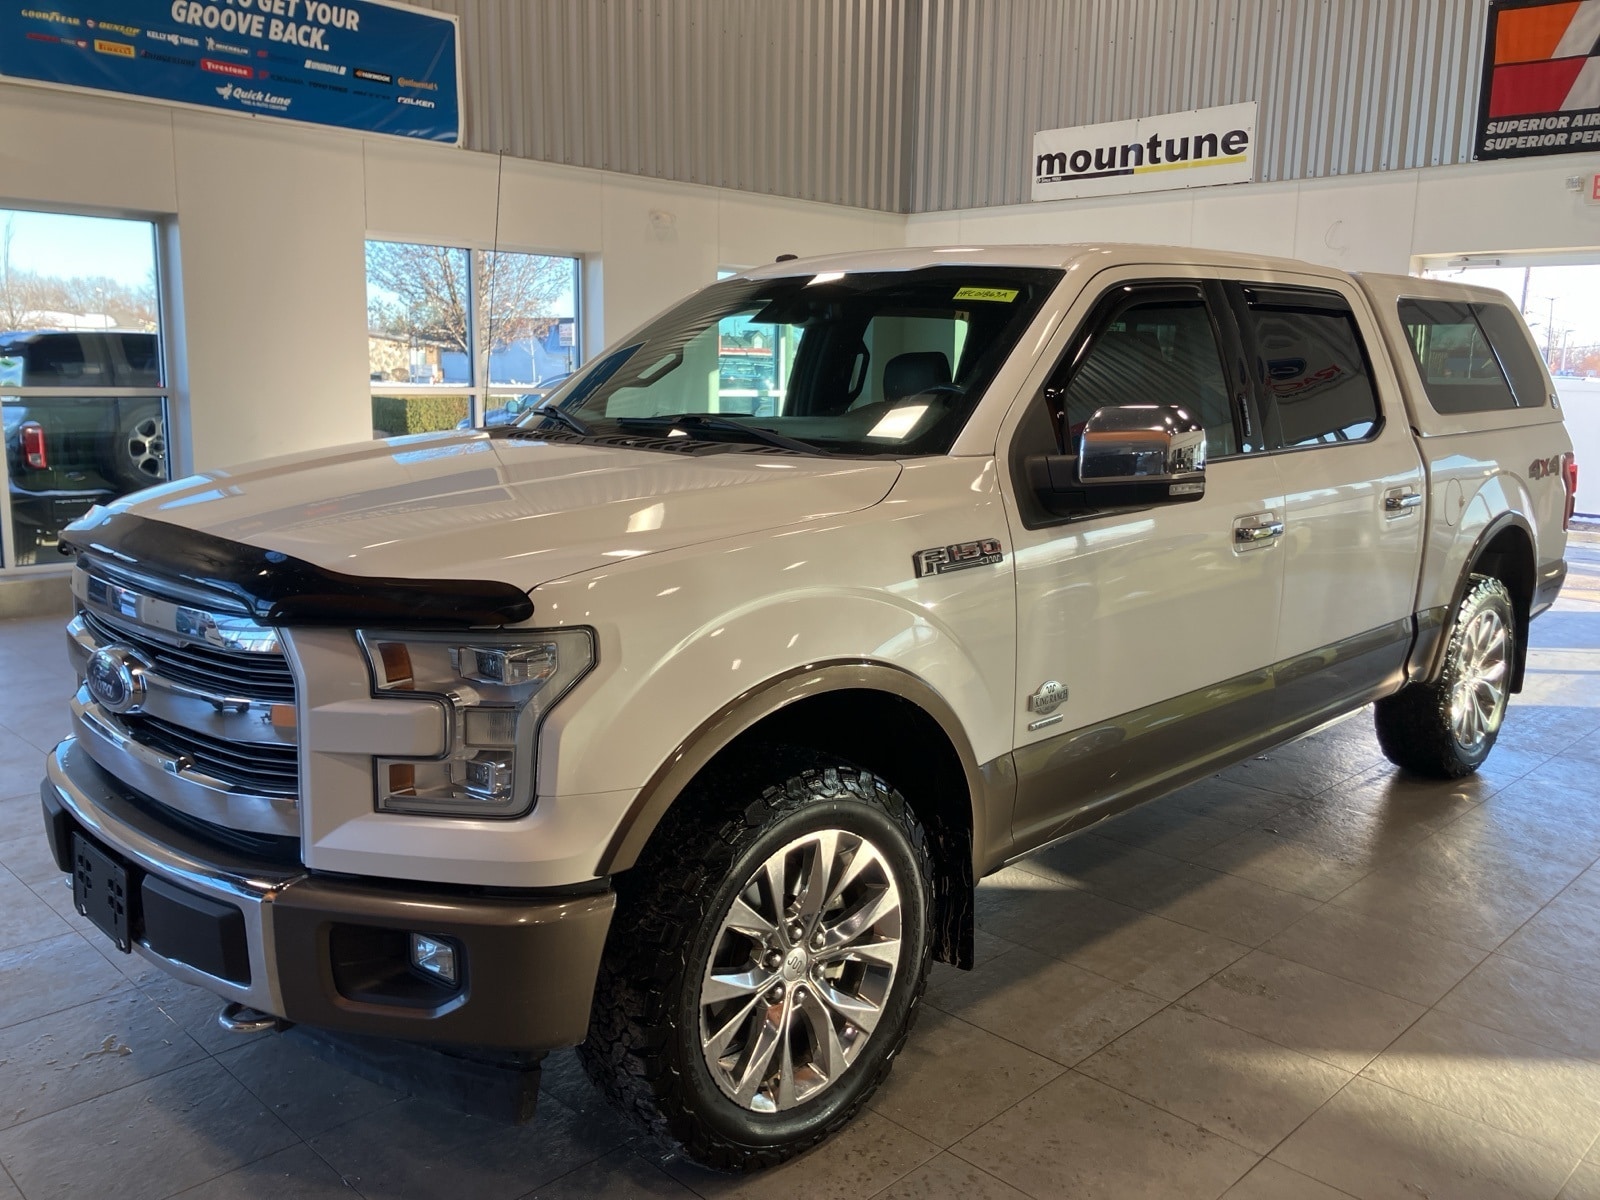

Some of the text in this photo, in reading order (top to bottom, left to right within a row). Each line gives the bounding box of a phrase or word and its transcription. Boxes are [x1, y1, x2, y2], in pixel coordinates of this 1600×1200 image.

[21, 9, 80, 26] GOODYEAR
[171, 0, 330, 51] GROOVE BACK.
[304, 0, 360, 31] YOUR
[233, 86, 292, 106] Quick Lane
[1486, 116, 1570, 135] SUPERIOR
[1483, 132, 1568, 151] SUPERIOR
[1036, 129, 1249, 177] mountune
